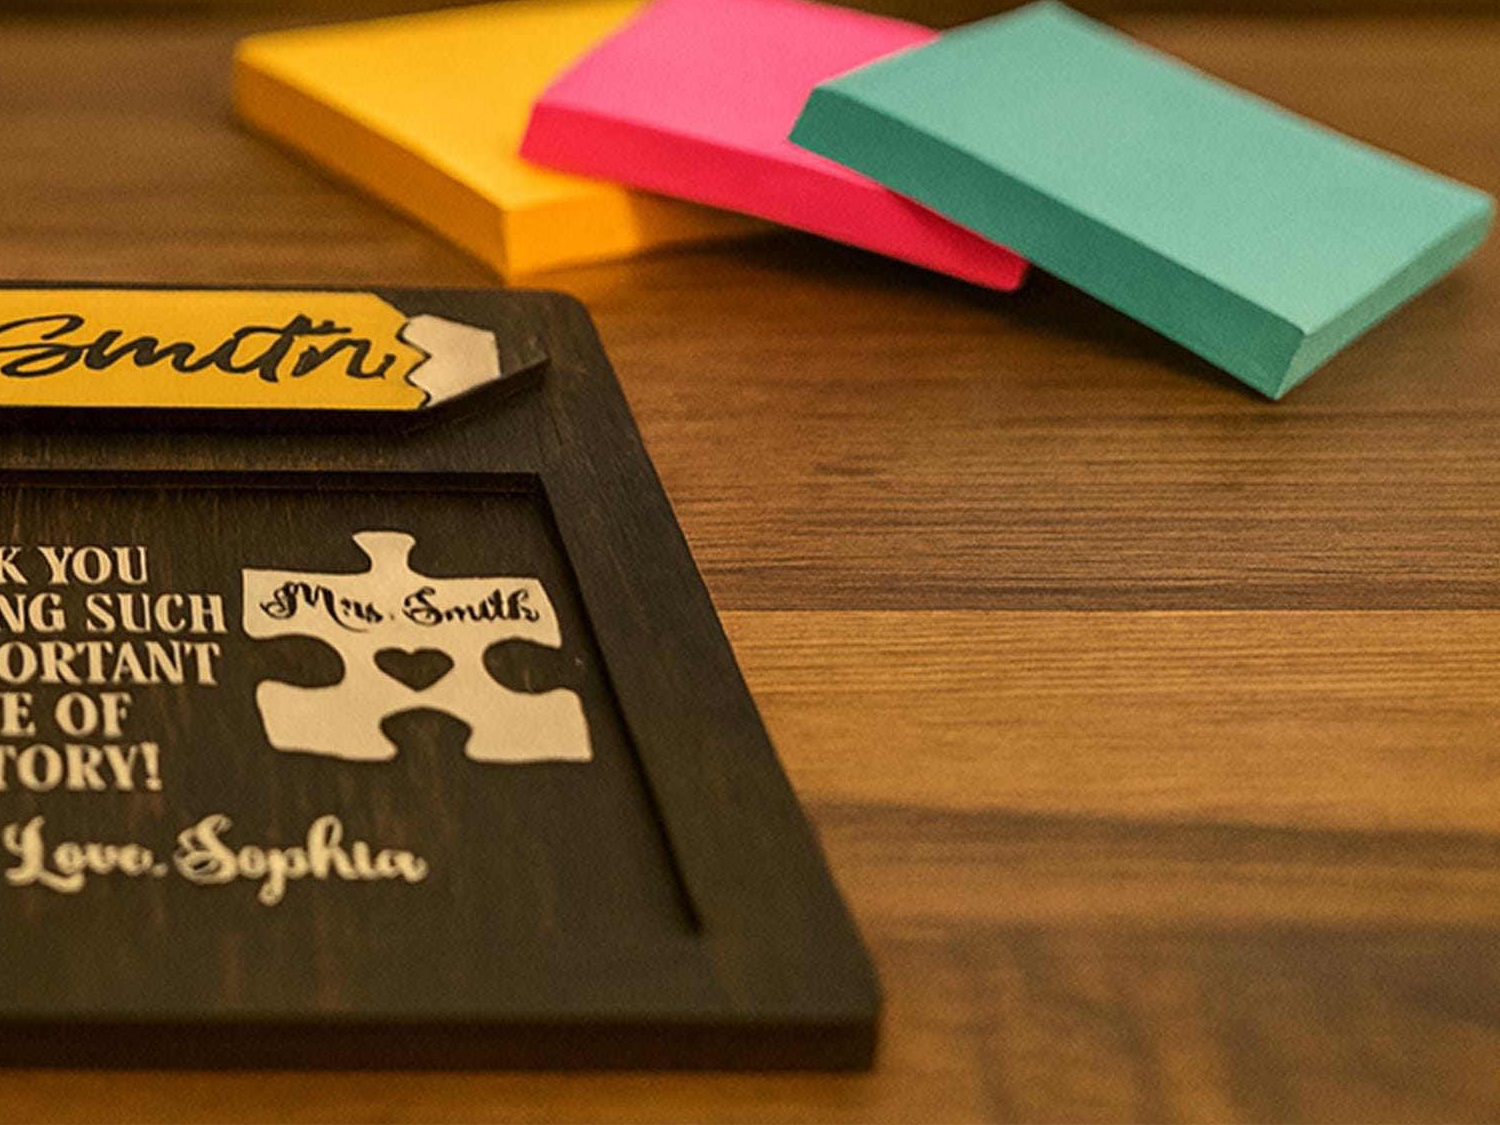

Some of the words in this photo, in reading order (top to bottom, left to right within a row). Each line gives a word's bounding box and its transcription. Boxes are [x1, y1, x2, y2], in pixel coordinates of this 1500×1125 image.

[40, 546, 150, 586] YOU
[84, 593, 229, 635] SUCH
[402, 585, 542, 627] Smith
[56, 691, 132, 738] OF
